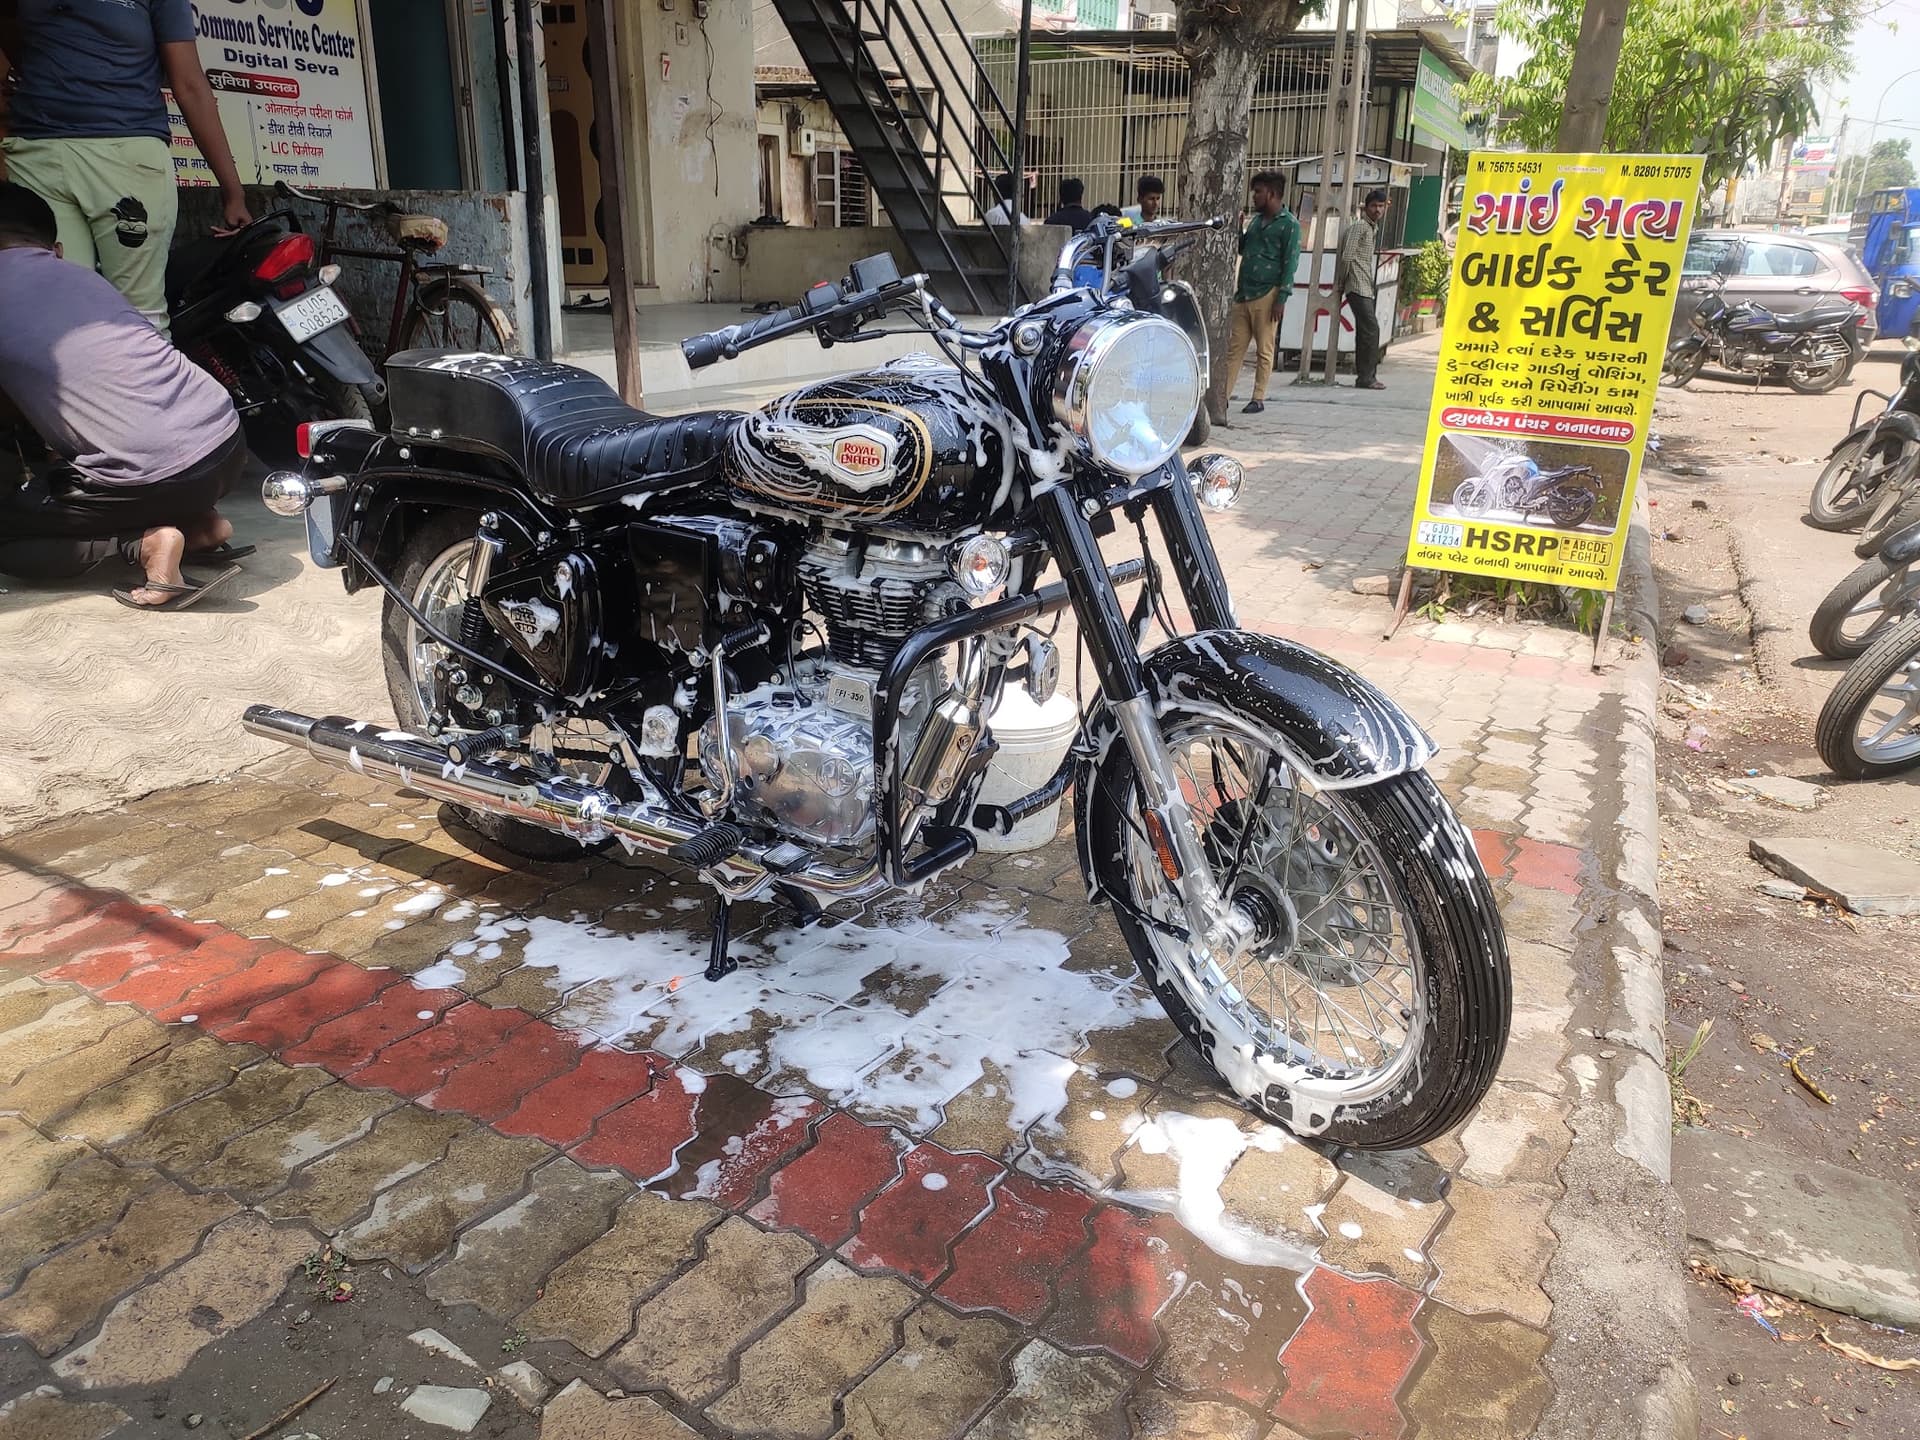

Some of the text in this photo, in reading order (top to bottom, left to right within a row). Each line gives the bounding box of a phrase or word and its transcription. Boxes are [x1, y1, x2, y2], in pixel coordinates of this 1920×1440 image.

[257, 14, 310, 53] Service
[311, 23, 355, 59] Center
[224, 47, 339, 76] Digital Seva
[662, 60, 670, 77] 7
[208, 72, 298, 95] सुविधा उपलब्ध
[288, 120, 305, 136] टीवी
[270, 141, 289, 155] LIC
[273, 163, 298, 175] फसल
[1477, 161, 1542, 174] M. 75675 54531
[1621, 165, 1692, 178] M. 82801 57075
[1575, 196, 1684, 240] સત્ય
[1461, 243, 1671, 296] બાઈક કેર
[296, 294, 328, 317] GJ05
[1468, 294, 1642, 343] & સર્વિસ
[1455, 340, 1647, 364] અમારે ત્યાં દરેક પ્રકારની
[1446, 358, 1647, 384] ટુ-વ્હીલર ગાડીનું વોશિંગ,
[1450, 373, 1493, 387] સર્વિસ
[1500, 376, 1533, 390] અને
[1606, 387, 1639, 399] કામ
[1445, 390, 1637, 416] ખાત્રી પૂર્વક કરી આપવામાં આવશે.
[1445, 411, 1631, 438] ટ્યુબલેસ પંચર બનાવનાર
[841, 454, 880, 467] ENFIELD
[844, 442, 876, 456] ROYAL
[1424, 533, 1460, 546] XX1234
[1466, 527, 1559, 557] HSRP
[1572, 540, 1608, 554] ABCDE
[1417, 546, 1608, 581] નંબર પ્લેટ બનાવી આપવામાં આવશે.
[1570, 550, 1606, 564] FGHIJ
